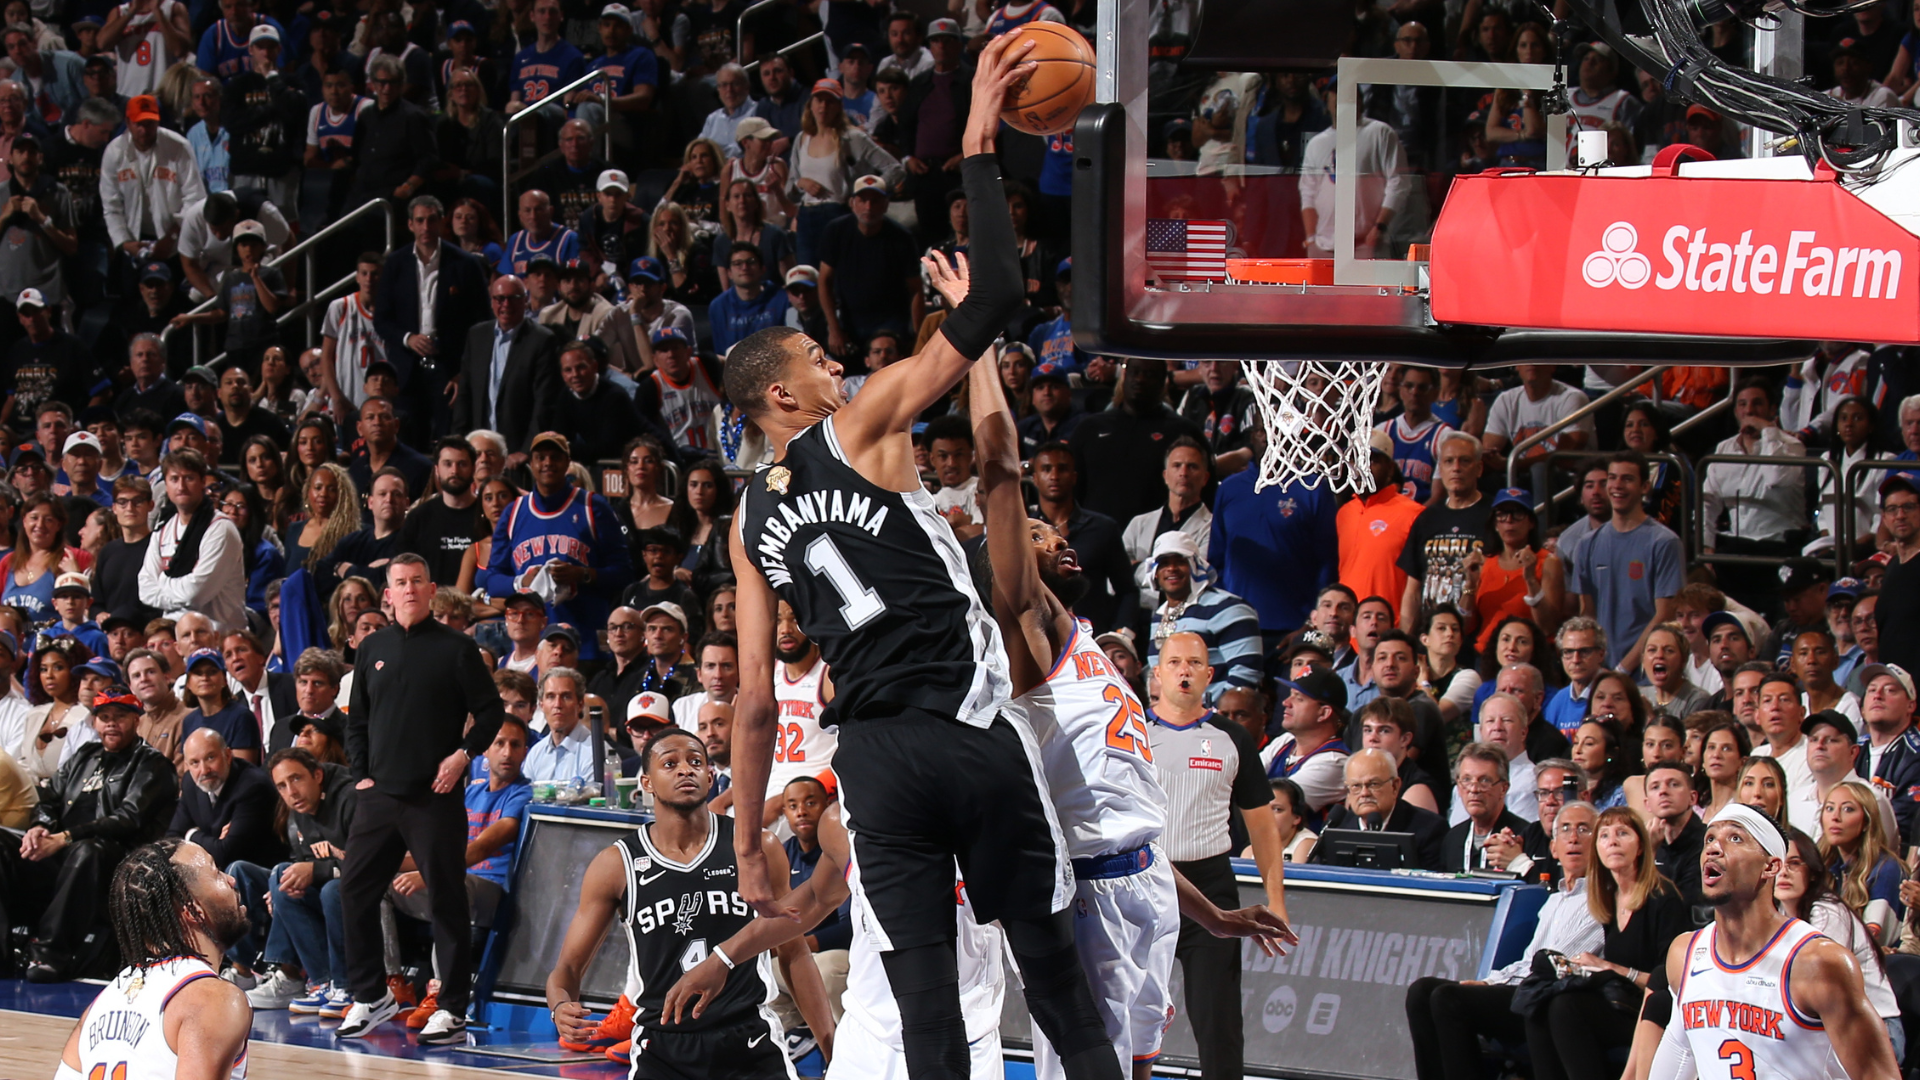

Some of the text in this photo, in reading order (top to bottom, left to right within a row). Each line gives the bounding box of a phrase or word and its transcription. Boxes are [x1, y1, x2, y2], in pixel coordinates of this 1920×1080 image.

[137, 40, 151, 66] 8
[1655, 225, 1902, 299] State Farm
[512, 534, 591, 570] NEW YORK
[758, 490, 889, 588] WEMBANYAMA
[1424, 538, 1484, 556] FINALS
[804, 532, 886, 632] 1
[775, 722, 806, 763] 32
[1102, 682, 1153, 765] 25
[1189, 760, 1222, 768] Emirates
[707, 868, 731, 877] LEDGER
[636, 890, 749, 936] SPURS
[679, 938, 709, 974] 4
[1319, 927, 1467, 986] KNIGHTS
[1265, 1000, 1293, 1017] abc
[1682, 1000, 1785, 1041] NEW YORK
[90, 1010, 150, 1052] BRUNSON
[1718, 1039, 1756, 1080] 3
